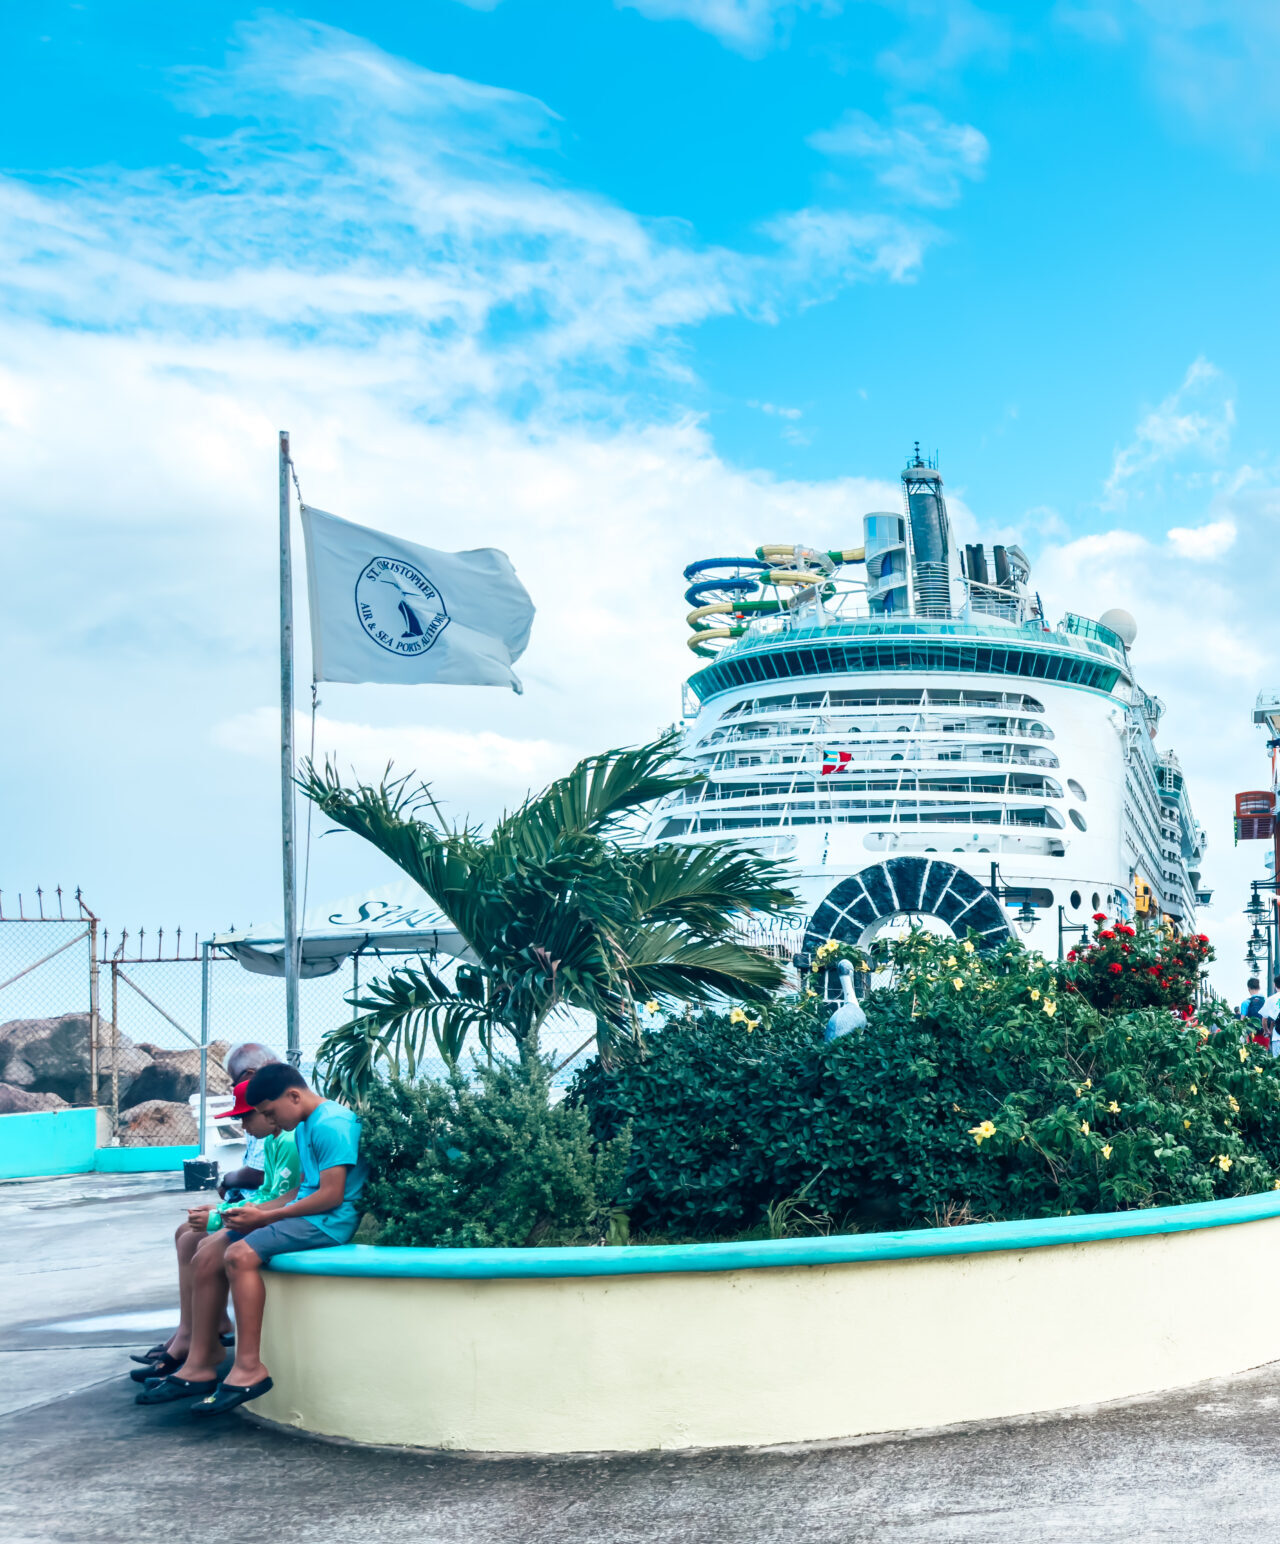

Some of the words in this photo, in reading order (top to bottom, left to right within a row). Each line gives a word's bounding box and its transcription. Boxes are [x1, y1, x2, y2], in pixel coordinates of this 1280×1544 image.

[366, 567, 382, 582] ST.
[360, 602, 374, 621] AIR
[367, 622, 377, 632] &
[375, 630, 394, 647] SEA
[395, 640, 422, 653] PORTS
